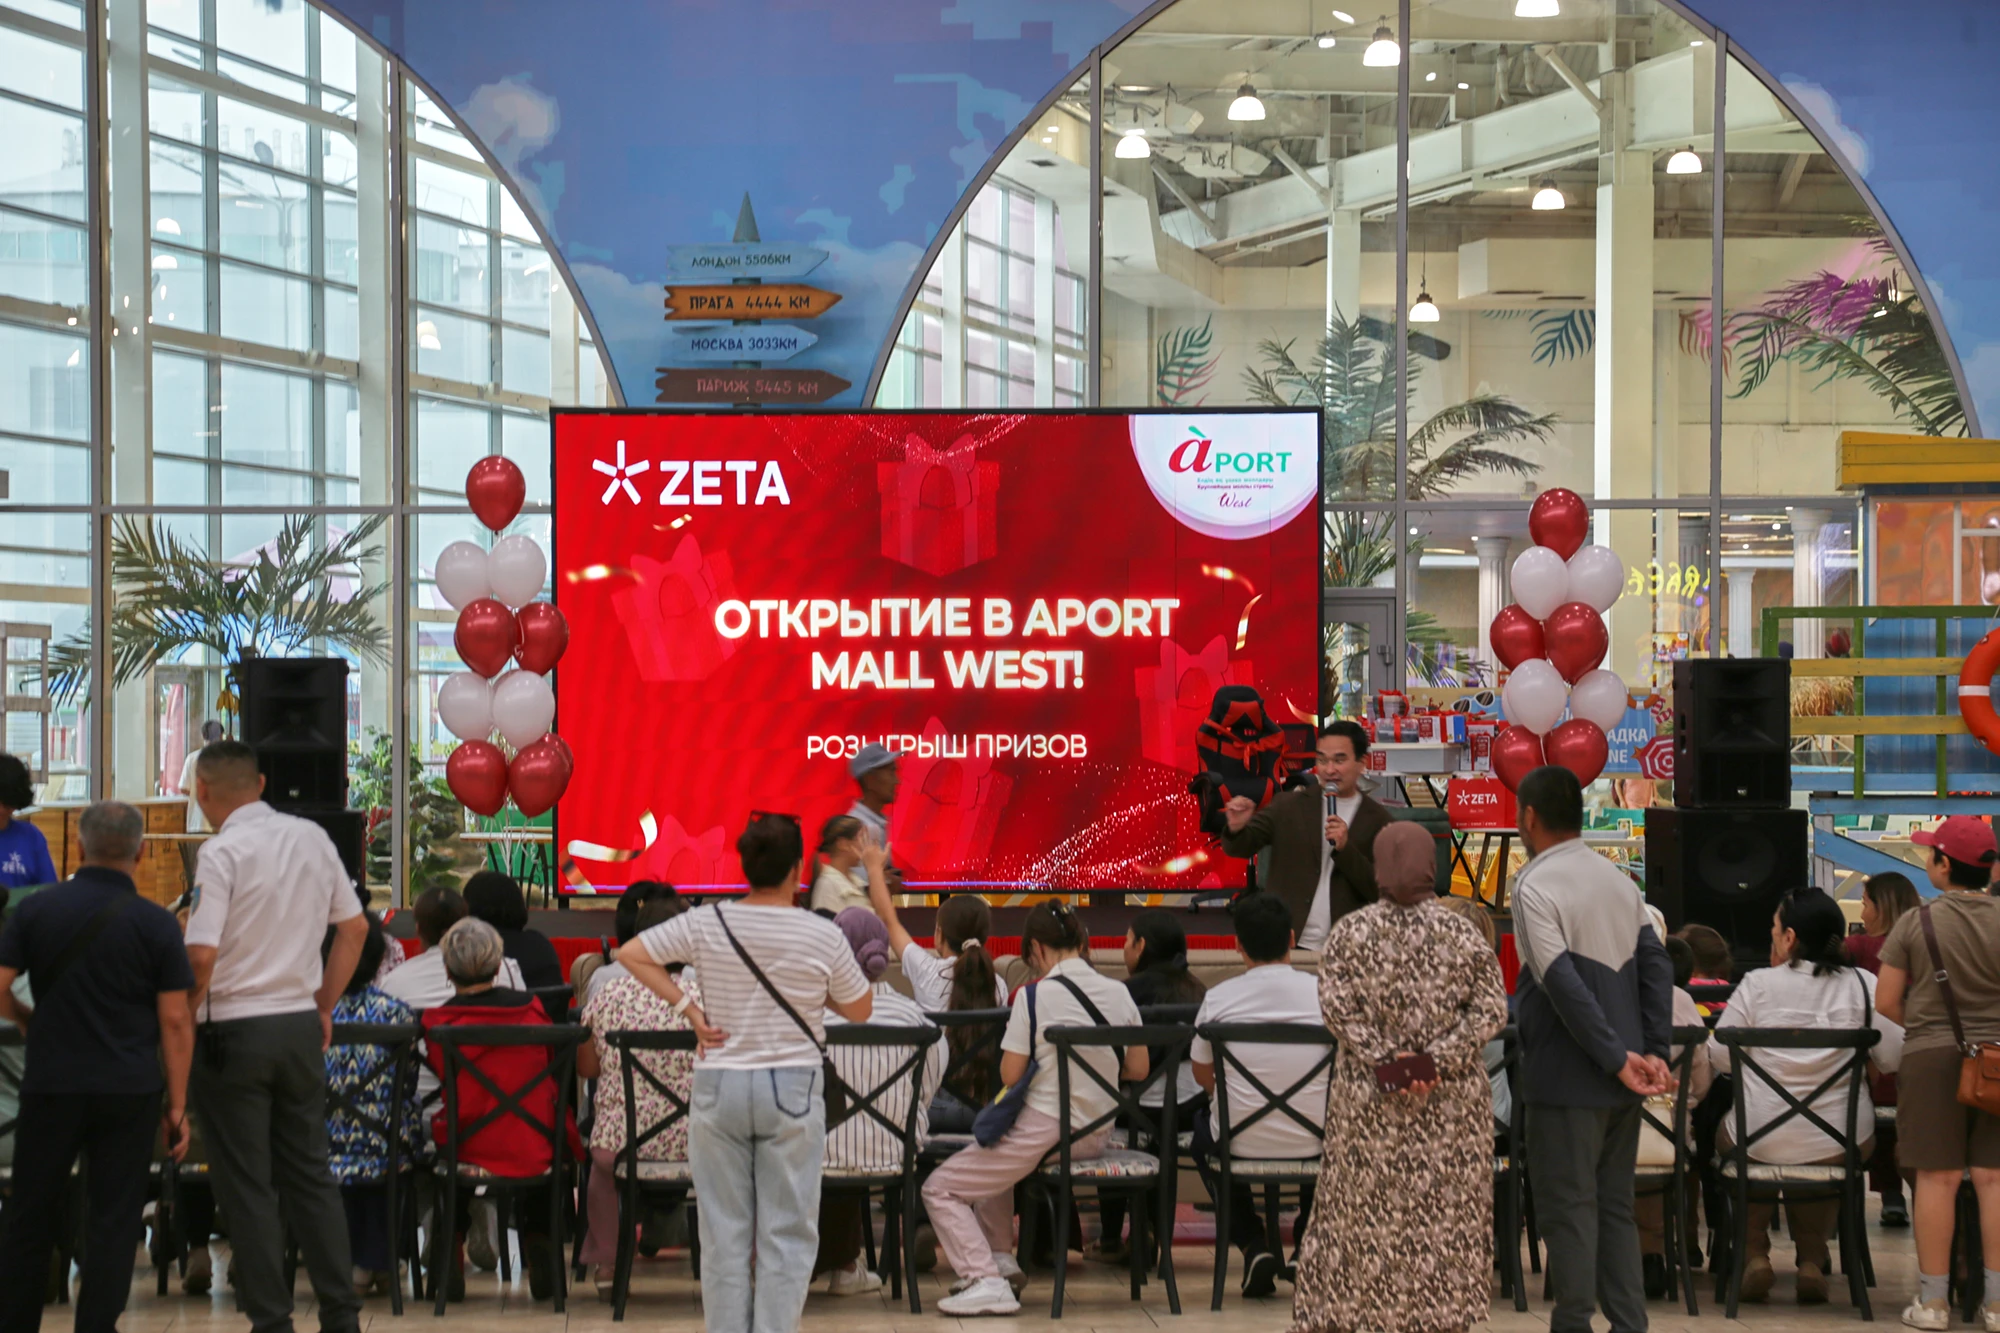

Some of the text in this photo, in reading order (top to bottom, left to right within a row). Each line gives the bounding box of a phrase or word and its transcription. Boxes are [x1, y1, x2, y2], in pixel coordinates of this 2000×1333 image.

[691, 253, 791, 268] ЛОНДОН 5506КМ
[689, 295, 810, 310] ПРАГА 4444 КМ
[691, 336, 798, 350] МОСКВА 3033КМ
[696, 378, 819, 395] ПАРИЖ 5445 КМ
[659, 460, 791, 505] ZETA
[1218, 492, 1252, 508] West
[714, 597, 1180, 639] ОТКРЫТИЕ В APORT
[811, 650, 1085, 690] MALL WEST!
[1607, 728, 1648, 744] АДКА
[975, 734, 1088, 759] ПРИЗОВ
[1608, 749, 1628, 763] NE
[1471, 793, 1498, 804] ZETA
